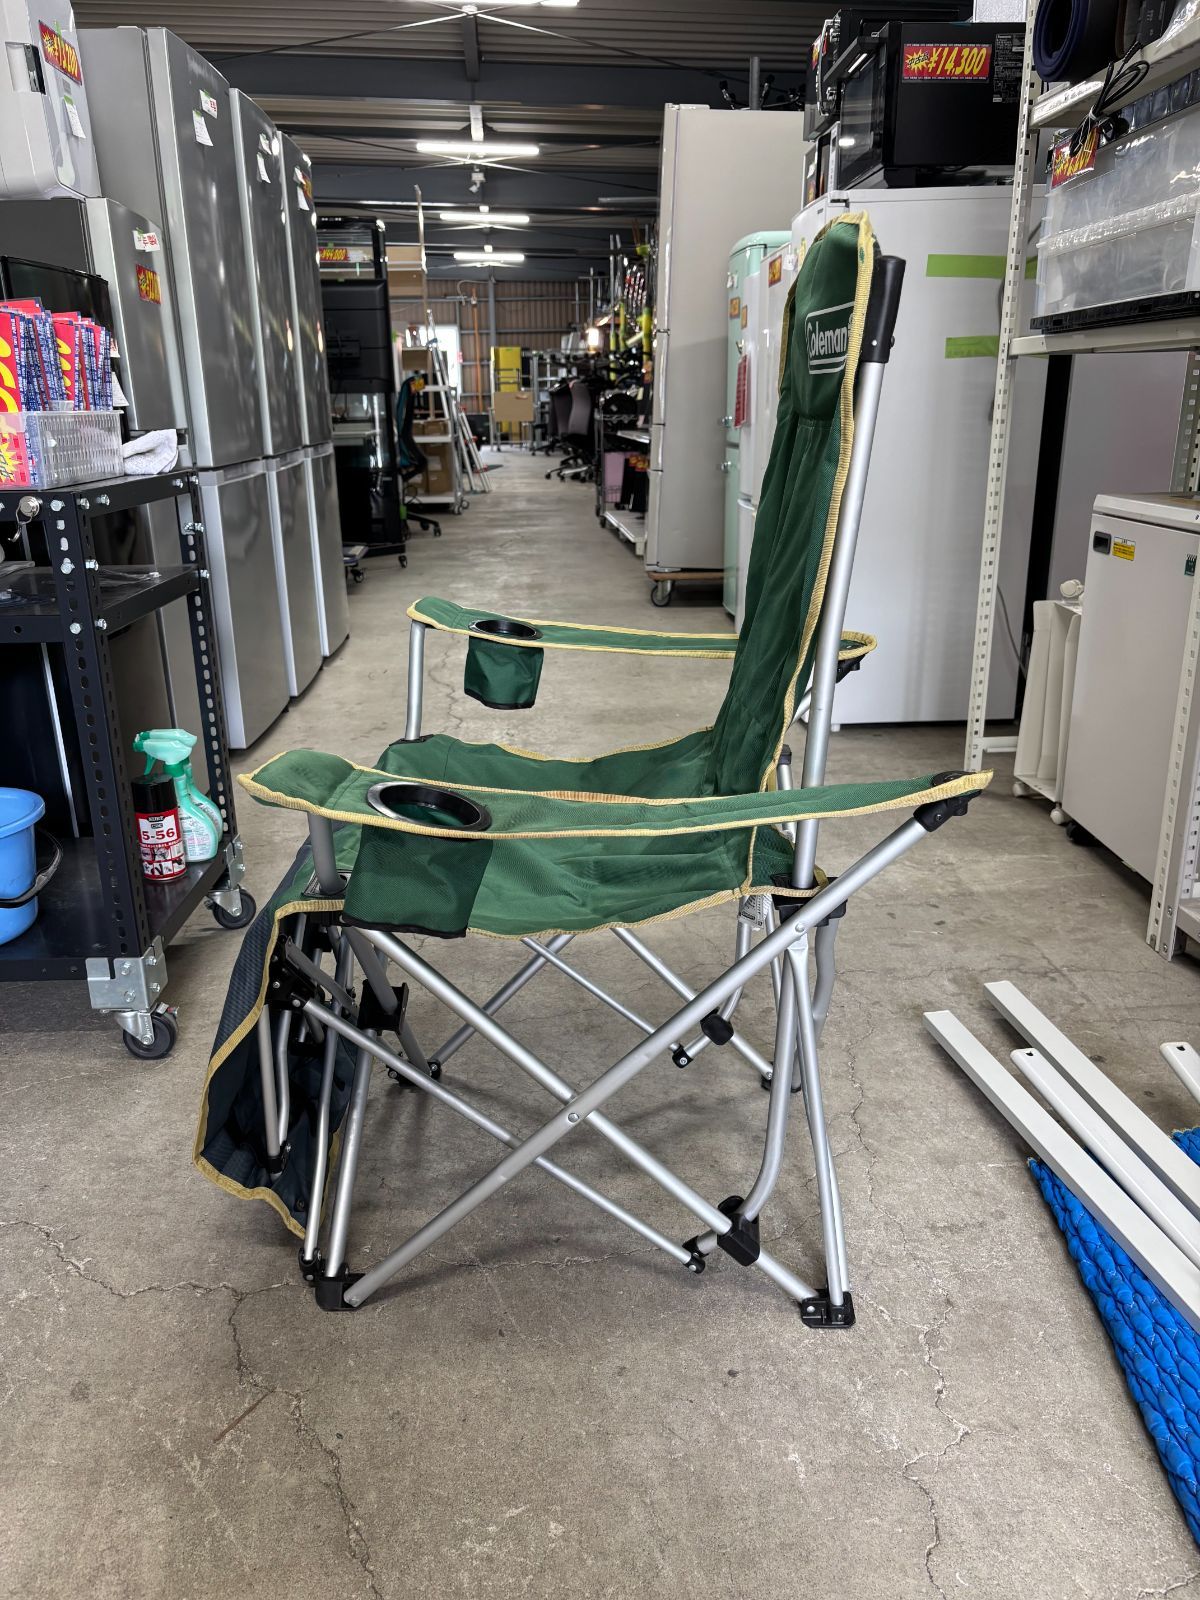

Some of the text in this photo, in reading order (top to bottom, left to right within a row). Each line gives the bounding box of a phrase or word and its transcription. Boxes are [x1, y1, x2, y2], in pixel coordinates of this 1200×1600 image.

[928, 47, 987, 75] ¥14,300
[806, 320, 848, 358] Coleman
[142, 828, 175, 841] 5-56
